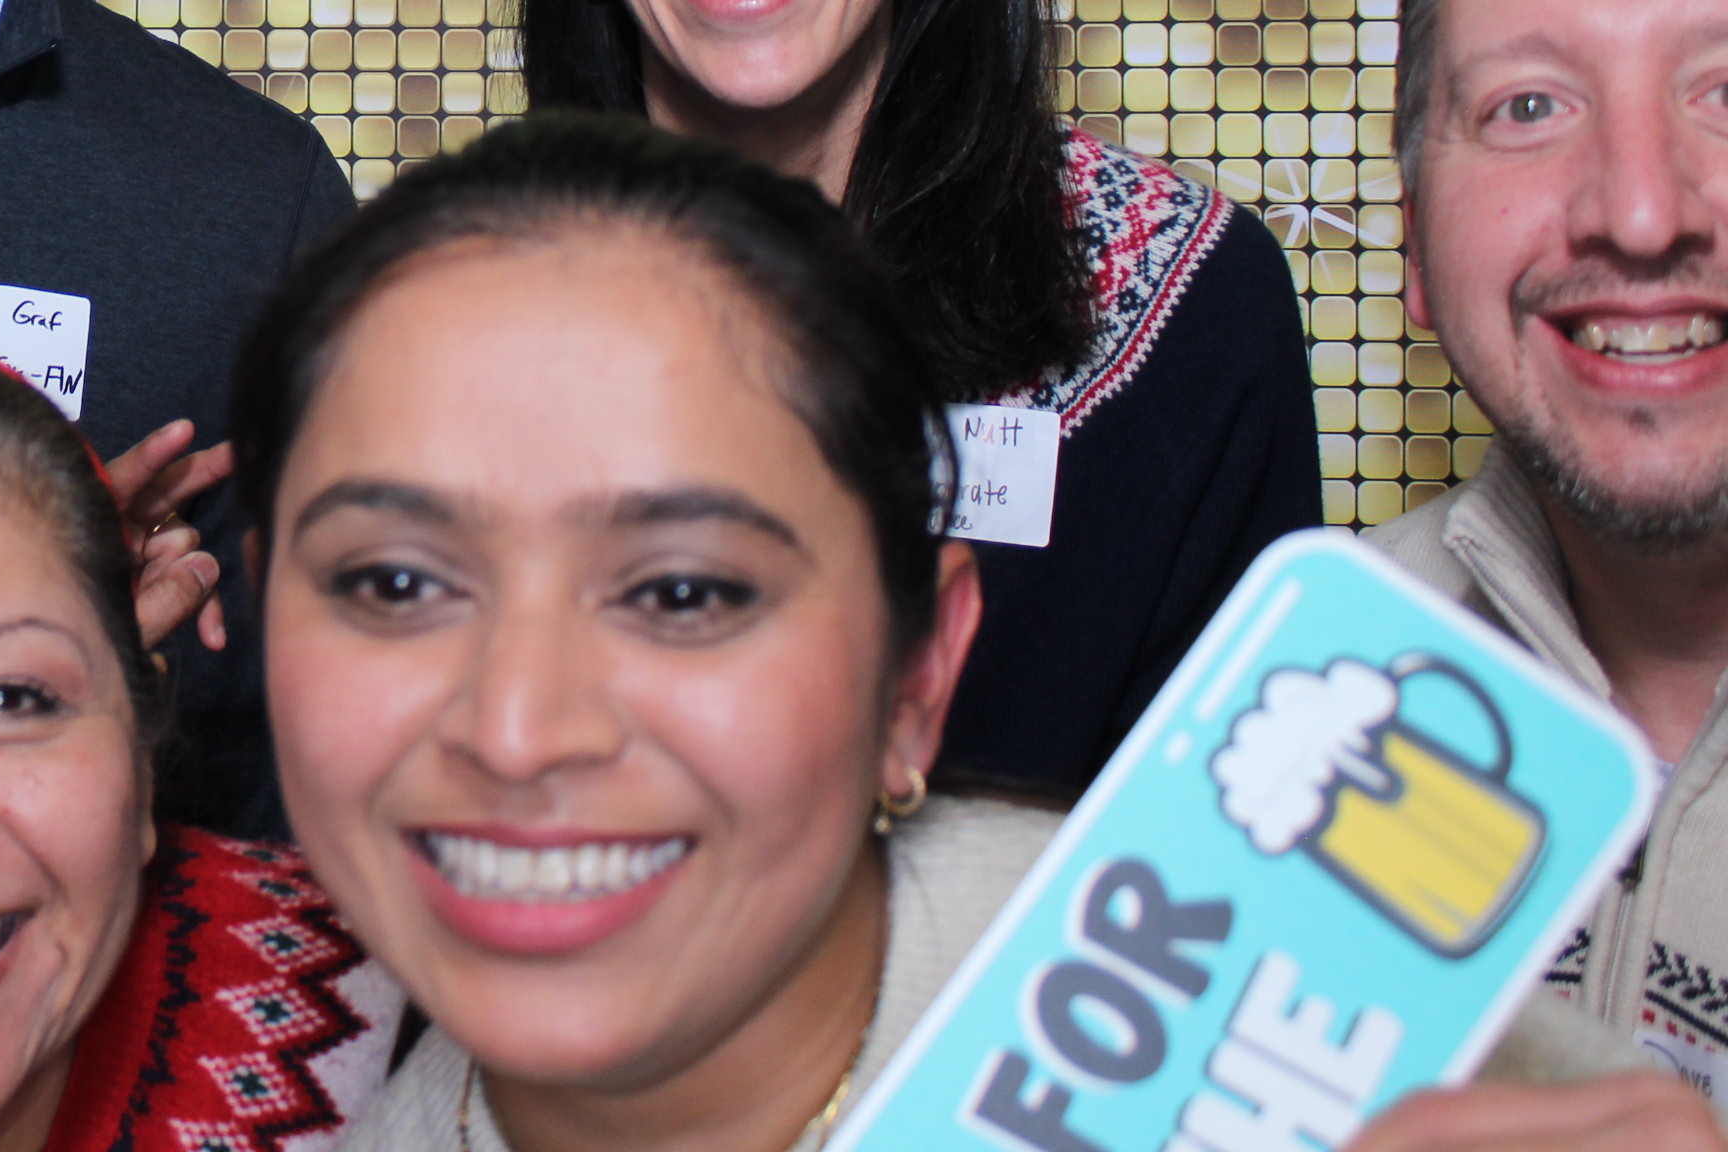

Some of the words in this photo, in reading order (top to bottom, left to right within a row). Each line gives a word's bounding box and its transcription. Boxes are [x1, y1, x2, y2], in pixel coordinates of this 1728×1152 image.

[12, 300, 63, 332] Graf
[962, 856, 1234, 1152] FOR
[1160, 949, 1405, 1152] HE
